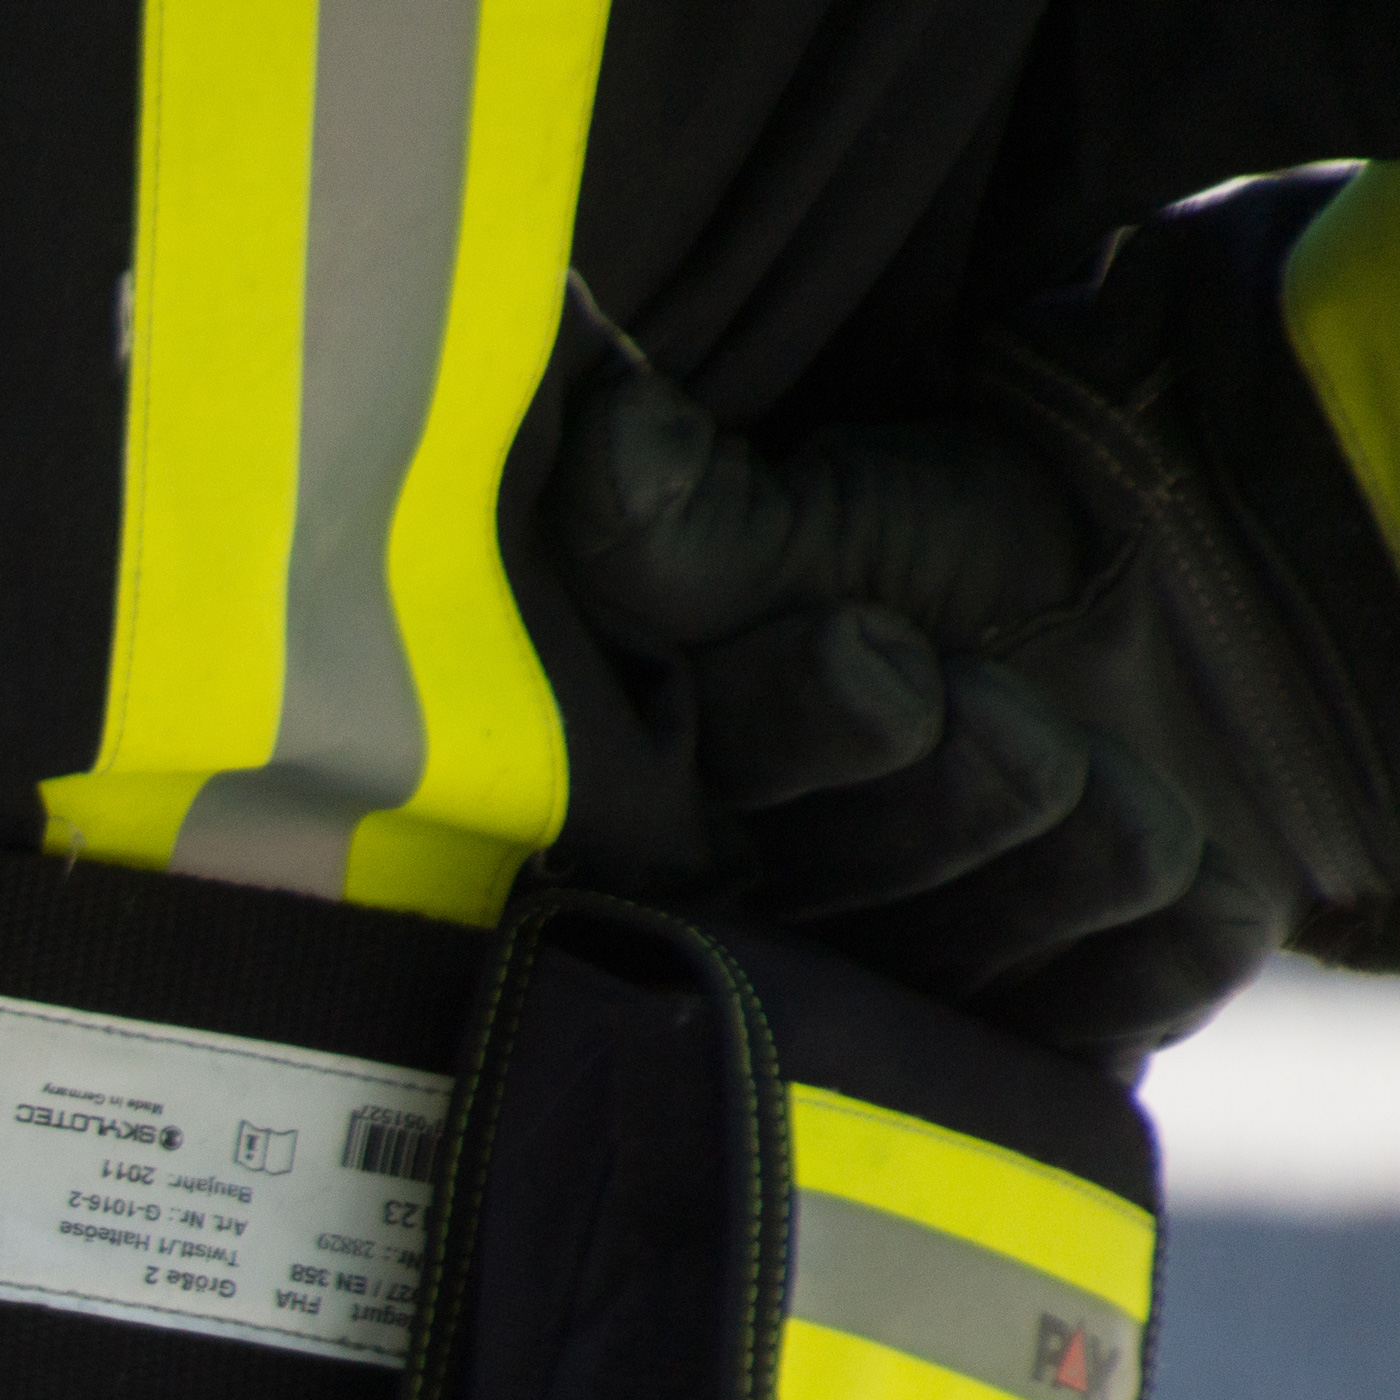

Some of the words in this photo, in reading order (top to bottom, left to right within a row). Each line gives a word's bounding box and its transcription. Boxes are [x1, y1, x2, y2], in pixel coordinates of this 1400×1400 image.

[42, 1083, 105, 1105] Germany
[109, 1095, 123, 1109] in
[127, 1098, 163, 1116] Made
[14, 1104, 157, 1145] SKYLOTEC
[100, 1160, 156, 1185] 2011
[168, 1176, 253, 1203] Baujahr:
[67, 1191, 162, 1221] G-1016-2
[168, 1208, 205, 1229] Nr.:
[213, 1215, 247, 1237] Art.
[59, 1220, 151, 1252] Halteöse
[144, 1266, 160, 1285] 2
[166, 1269, 236, 1299] Größe
[290, 1264, 331, 1287] 358
[335, 1272, 368, 1295] EN
[274, 1289, 322, 1316] FHA
[386, 1284, 417, 1303] 27
[350, 1304, 412, 1329] egurt
